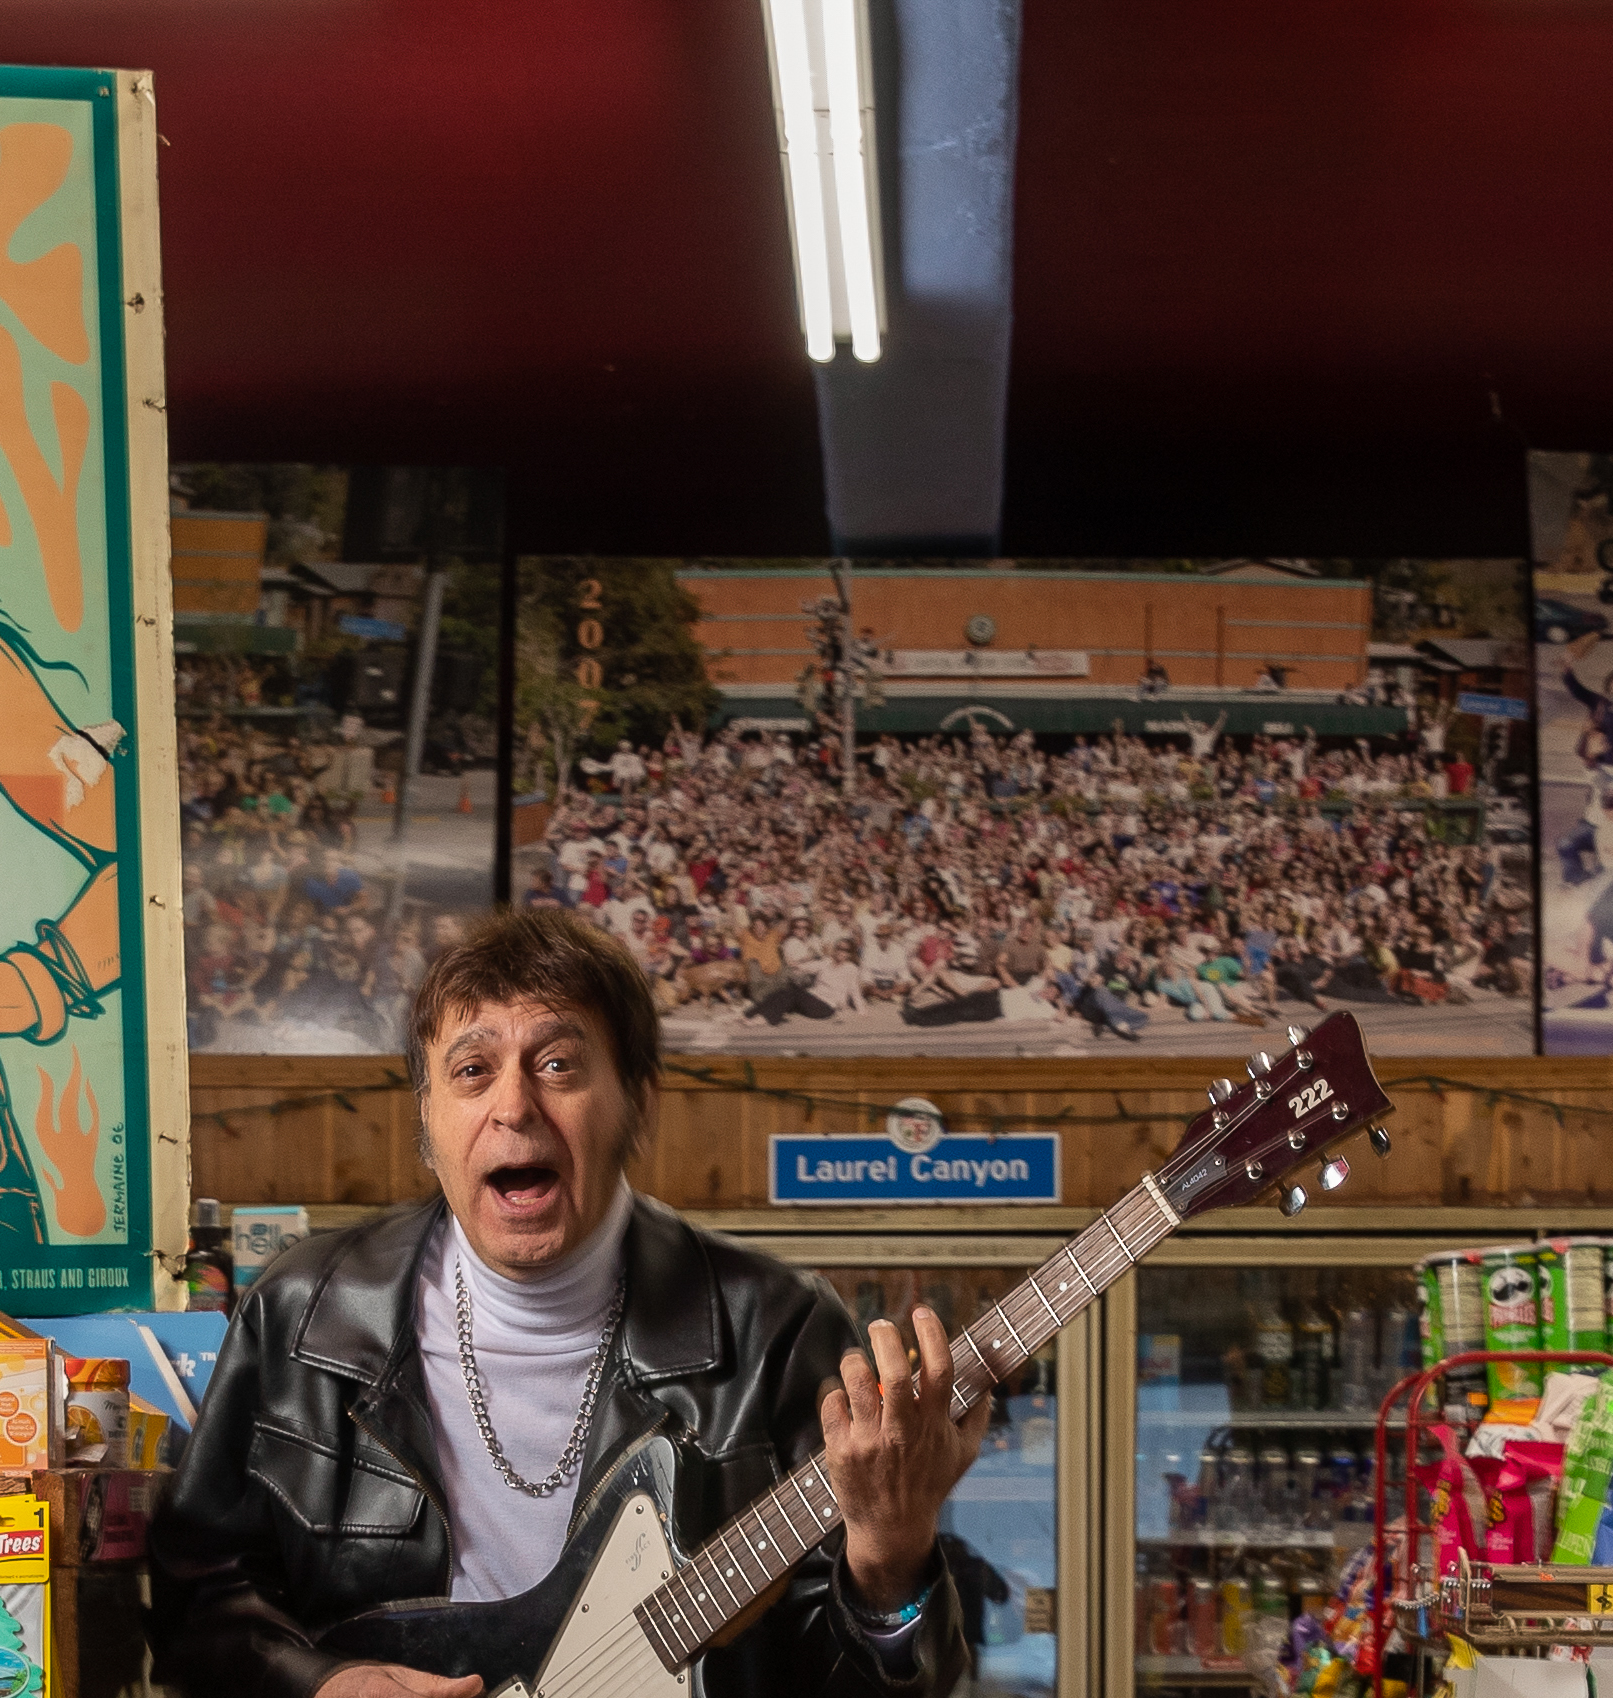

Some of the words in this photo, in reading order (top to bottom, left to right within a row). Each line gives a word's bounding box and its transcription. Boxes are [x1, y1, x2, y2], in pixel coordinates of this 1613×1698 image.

[1288, 1077, 1335, 1119] 222
[796, 1155, 899, 1183] Laurel
[909, 1153, 1030, 1188] Canyon
[12, 1269, 55, 1289] STRAUS
[61, 1269, 84, 1288] AND
[88, 1268, 130, 1288] GIROUX
[34, 1507, 45, 1528] 1
